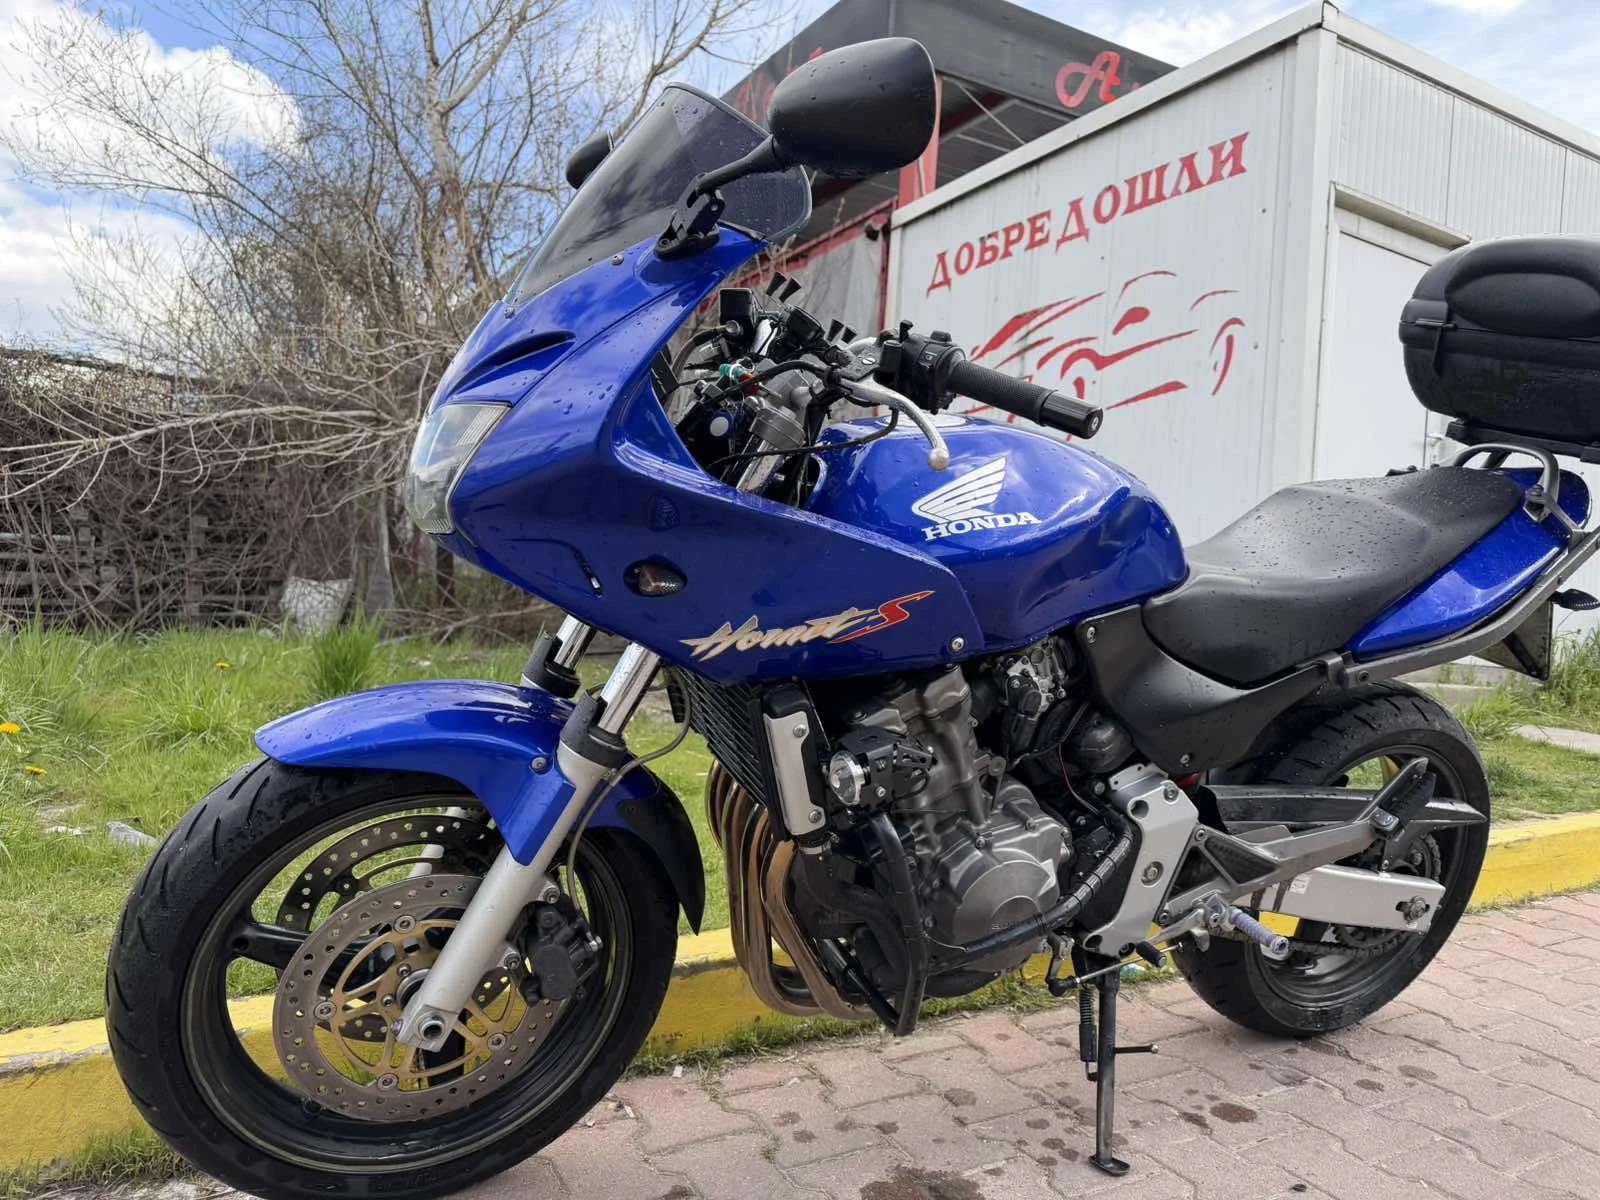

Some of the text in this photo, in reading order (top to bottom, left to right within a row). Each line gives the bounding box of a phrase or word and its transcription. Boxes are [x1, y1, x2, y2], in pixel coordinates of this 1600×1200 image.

[926, 131, 1250, 298] ДОБРЕ ДОШЛИ
[921, 510, 1042, 542] HONDA
